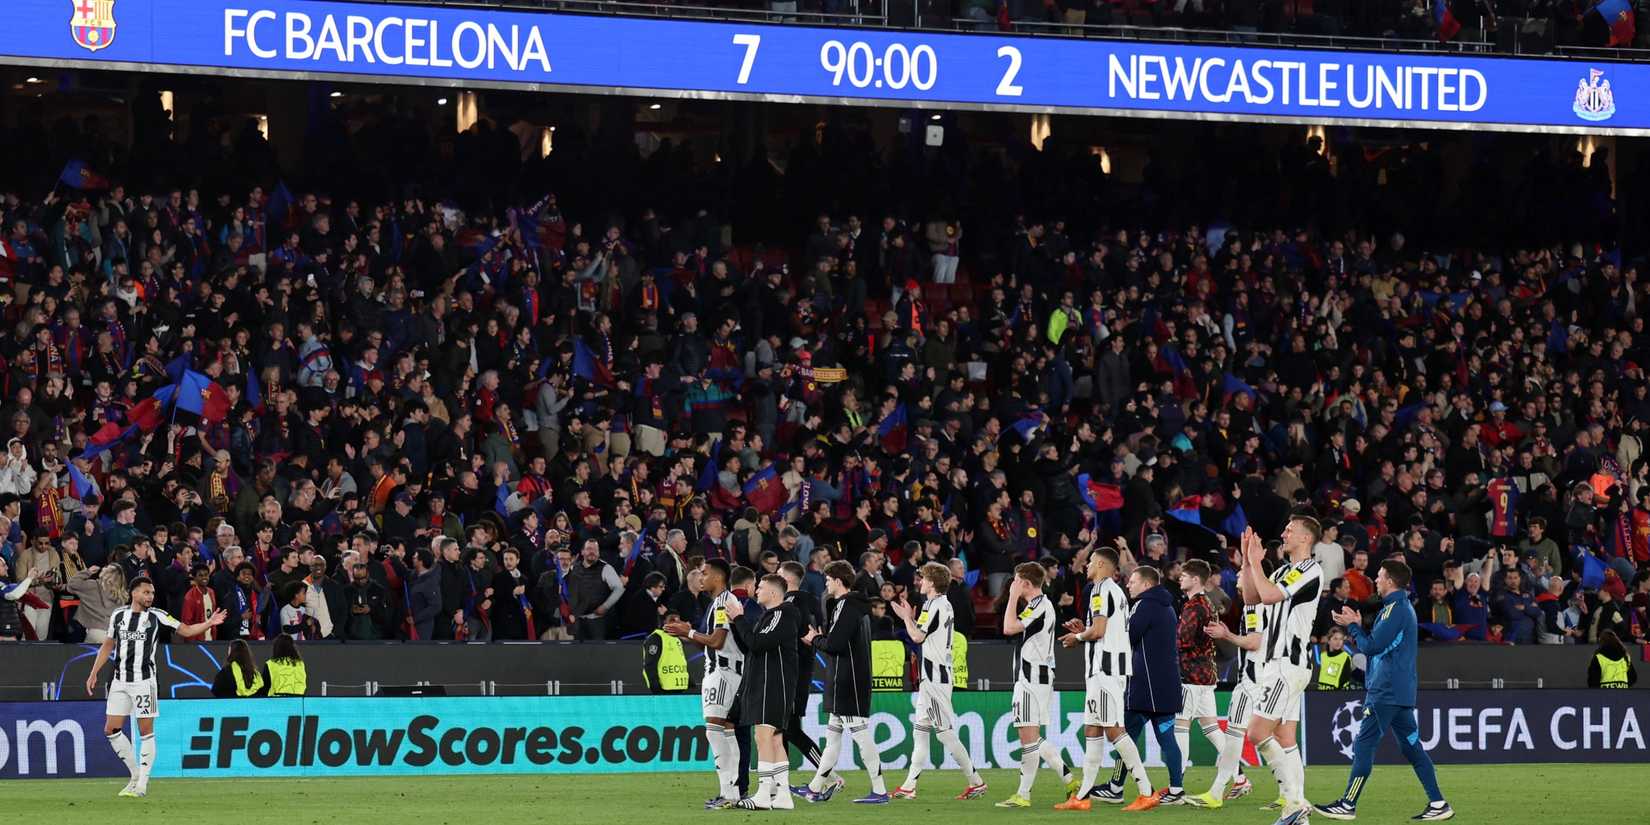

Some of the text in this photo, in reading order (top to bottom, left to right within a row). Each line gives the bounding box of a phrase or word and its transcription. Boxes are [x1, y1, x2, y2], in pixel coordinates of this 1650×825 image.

[224, 8, 552, 72] FC BARCELONA
[732, 34, 760, 84] 7
[820, 40, 938, 91] 90:00
[996, 46, 1023, 97] 2
[1107, 54, 1488, 112] NEWCASTLE UNITED
[1500, 493, 1508, 514] 9
[135, 694, 151, 708] 23
[704, 688, 717, 702] 28
[216, 714, 710, 769] FollowScores.com
[1412, 706, 1647, 751] UEFA CHA
